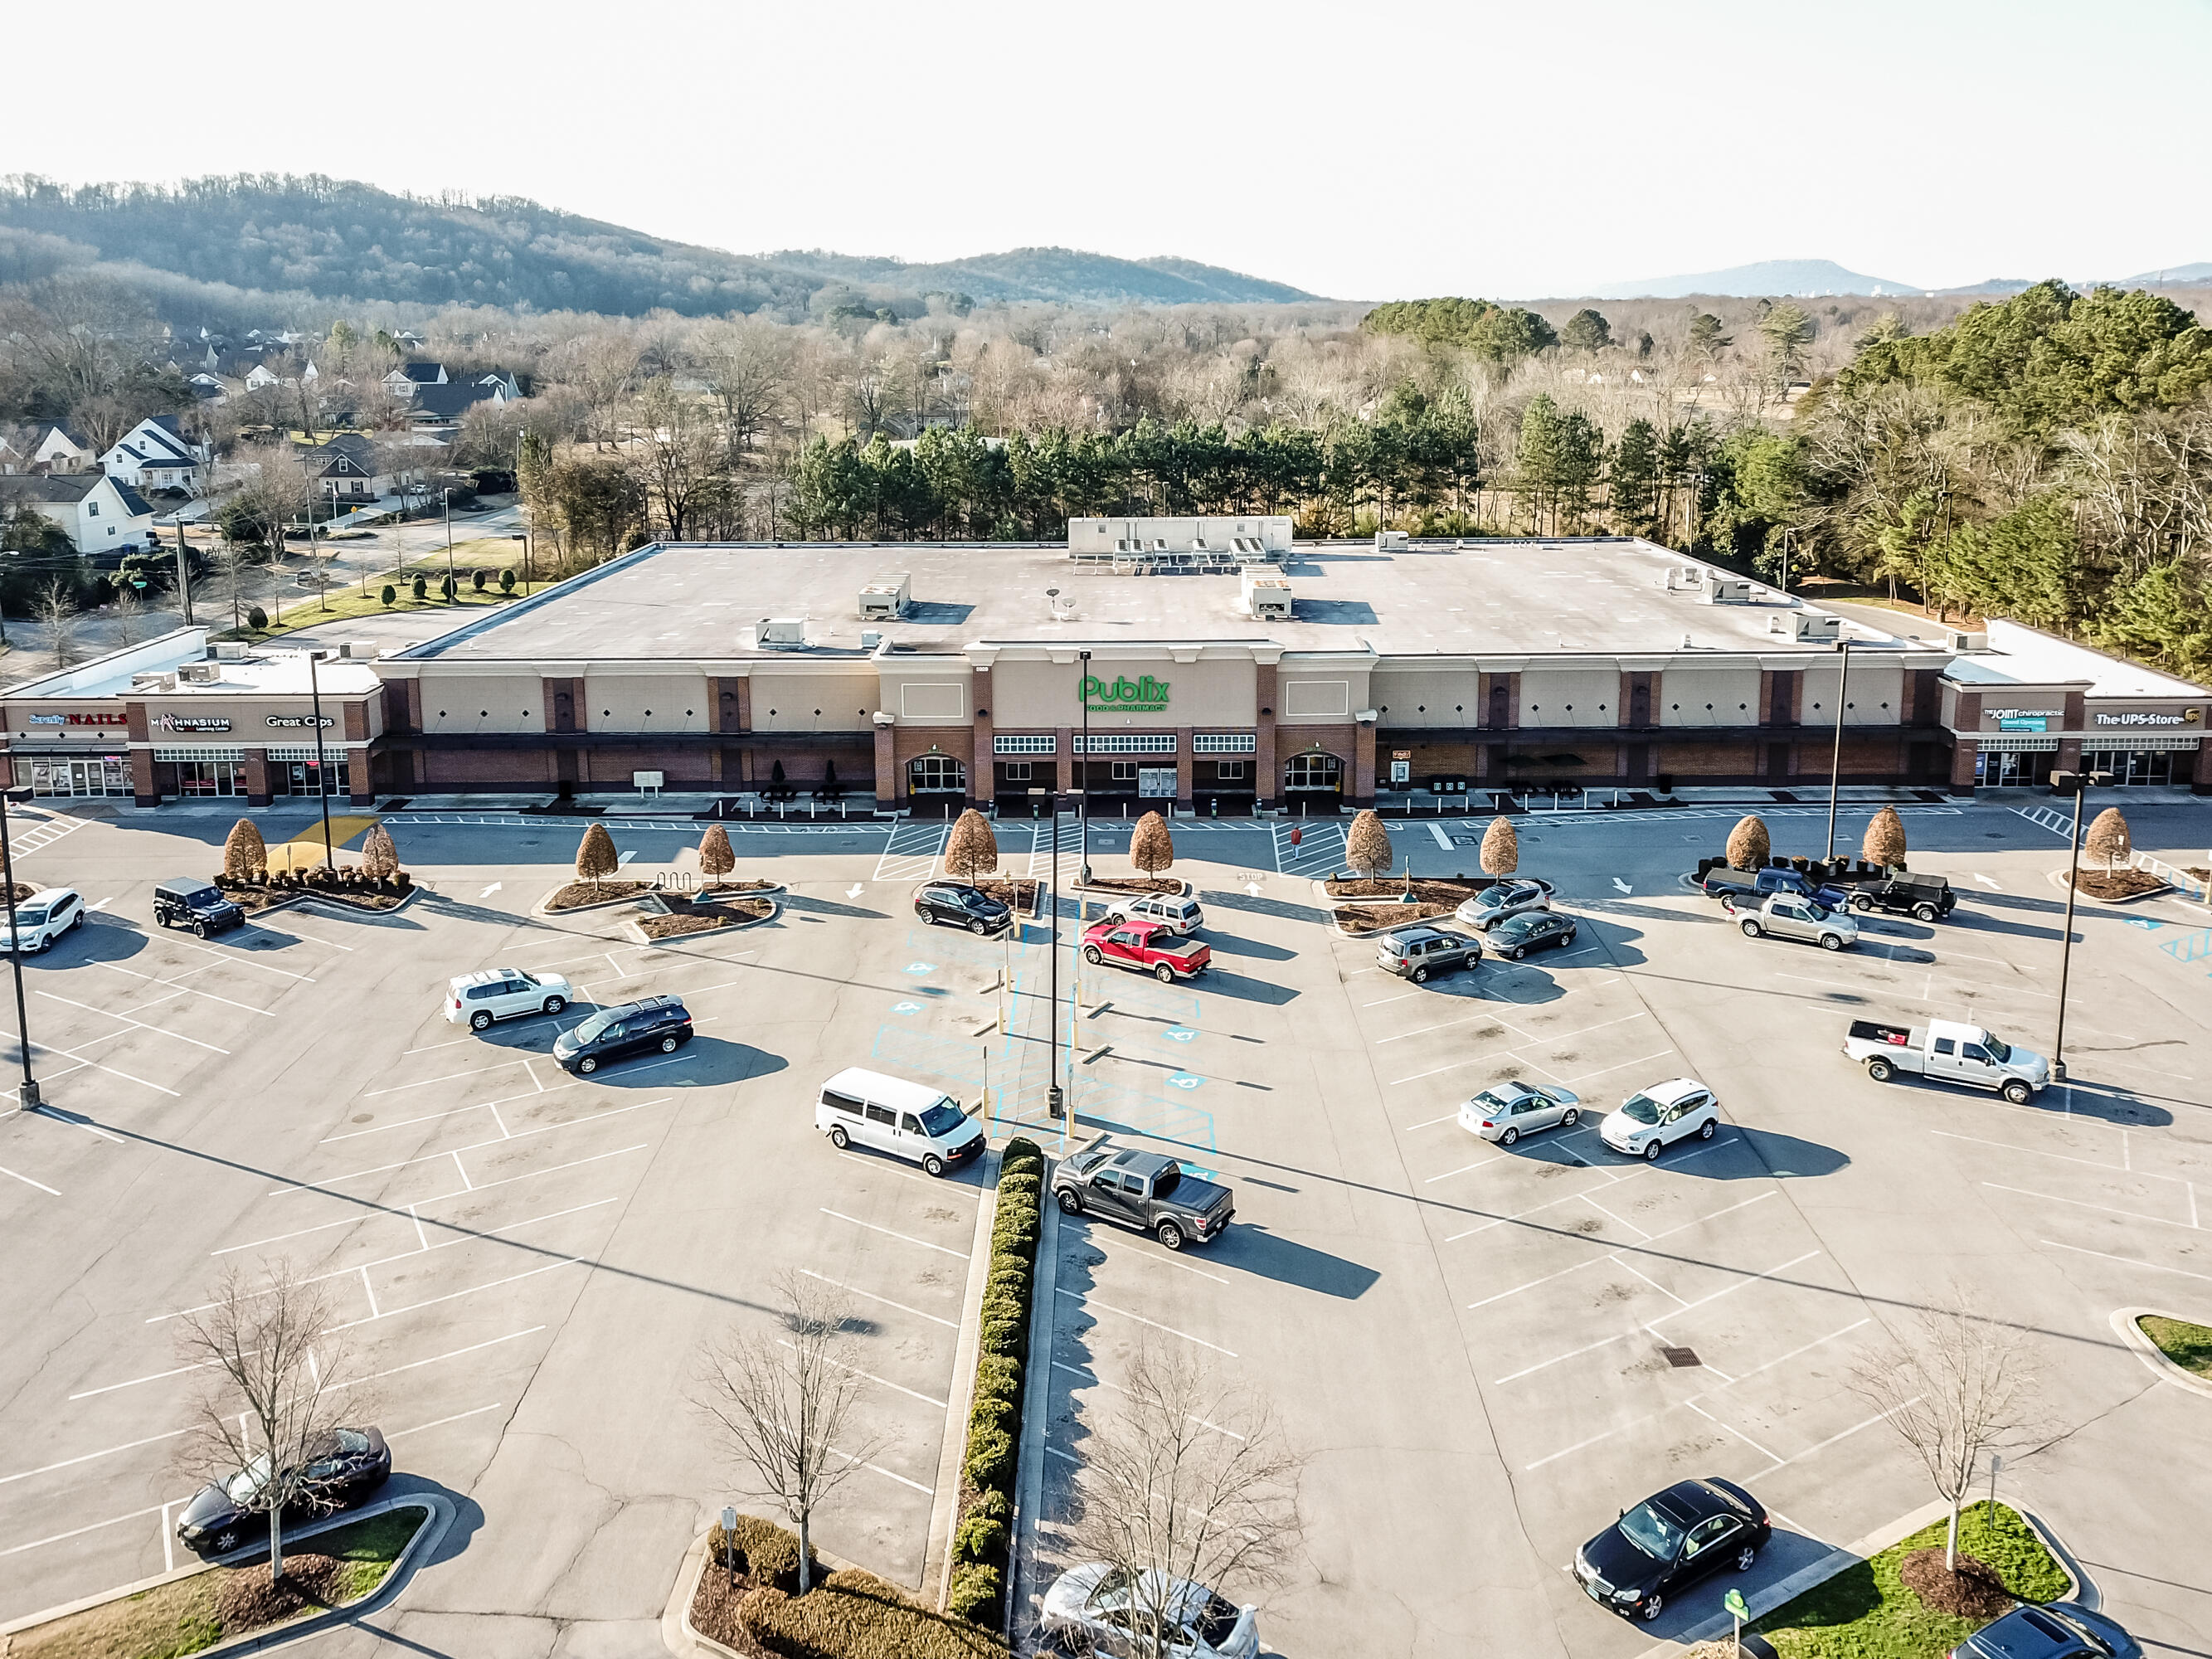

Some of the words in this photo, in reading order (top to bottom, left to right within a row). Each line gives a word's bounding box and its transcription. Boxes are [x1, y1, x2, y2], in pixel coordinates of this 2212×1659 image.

[1079, 675, 1169, 703] Publix
[68, 713, 127, 725] NAILS
[1991, 709, 2020, 719] JOINT
[2097, 713, 2118, 725] The
[2121, 713, 2146, 725] UPS
[2147, 713, 2180, 725] Store
[151, 713, 230, 732] MATHNASIUM
[265, 716, 302, 727] Great
[304, 716, 333, 728] Clps
